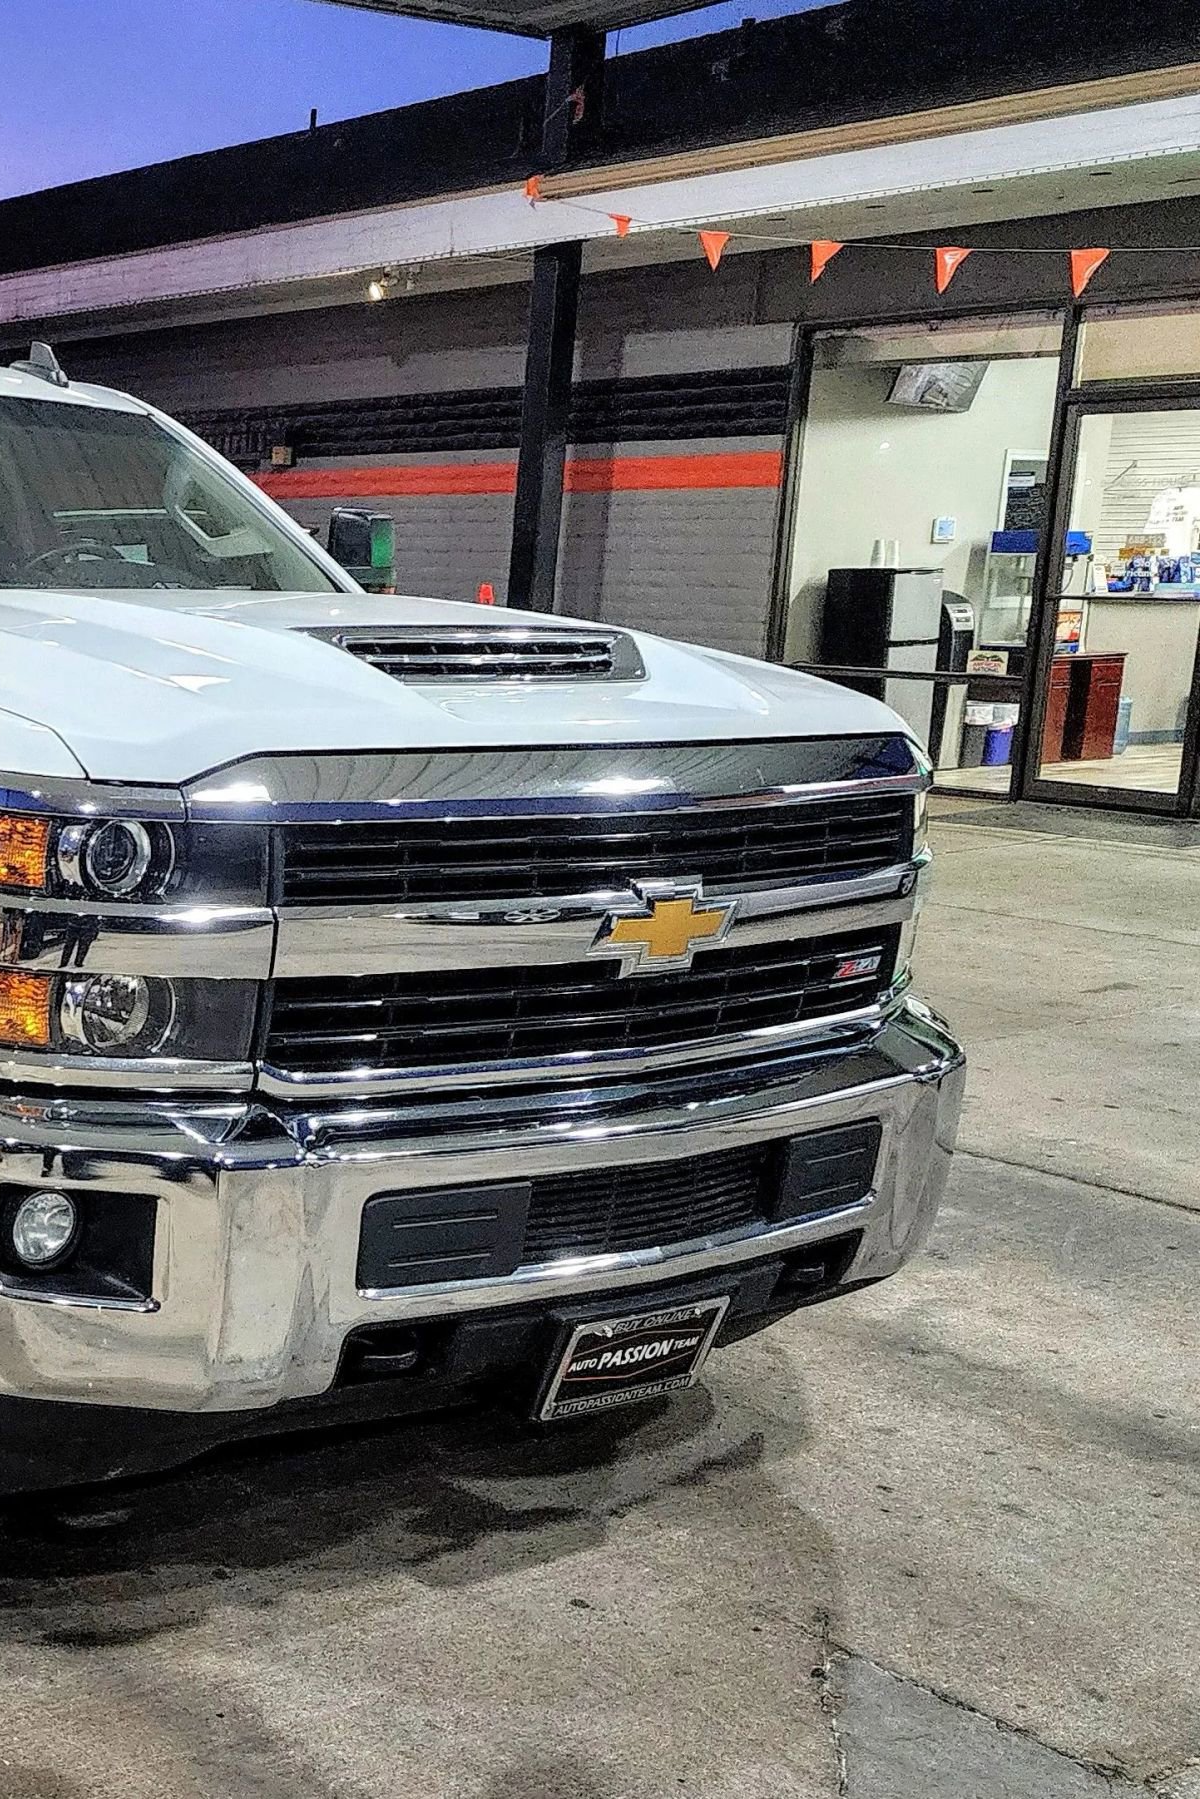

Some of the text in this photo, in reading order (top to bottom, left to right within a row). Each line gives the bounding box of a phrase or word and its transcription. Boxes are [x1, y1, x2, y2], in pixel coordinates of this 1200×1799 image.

[614, 1319, 642, 1333] BUY
[567, 1336, 699, 1373] AUTO PASSION TEAM
[554, 1377, 689, 1415] AUTOPASSIONTEAM.COM
